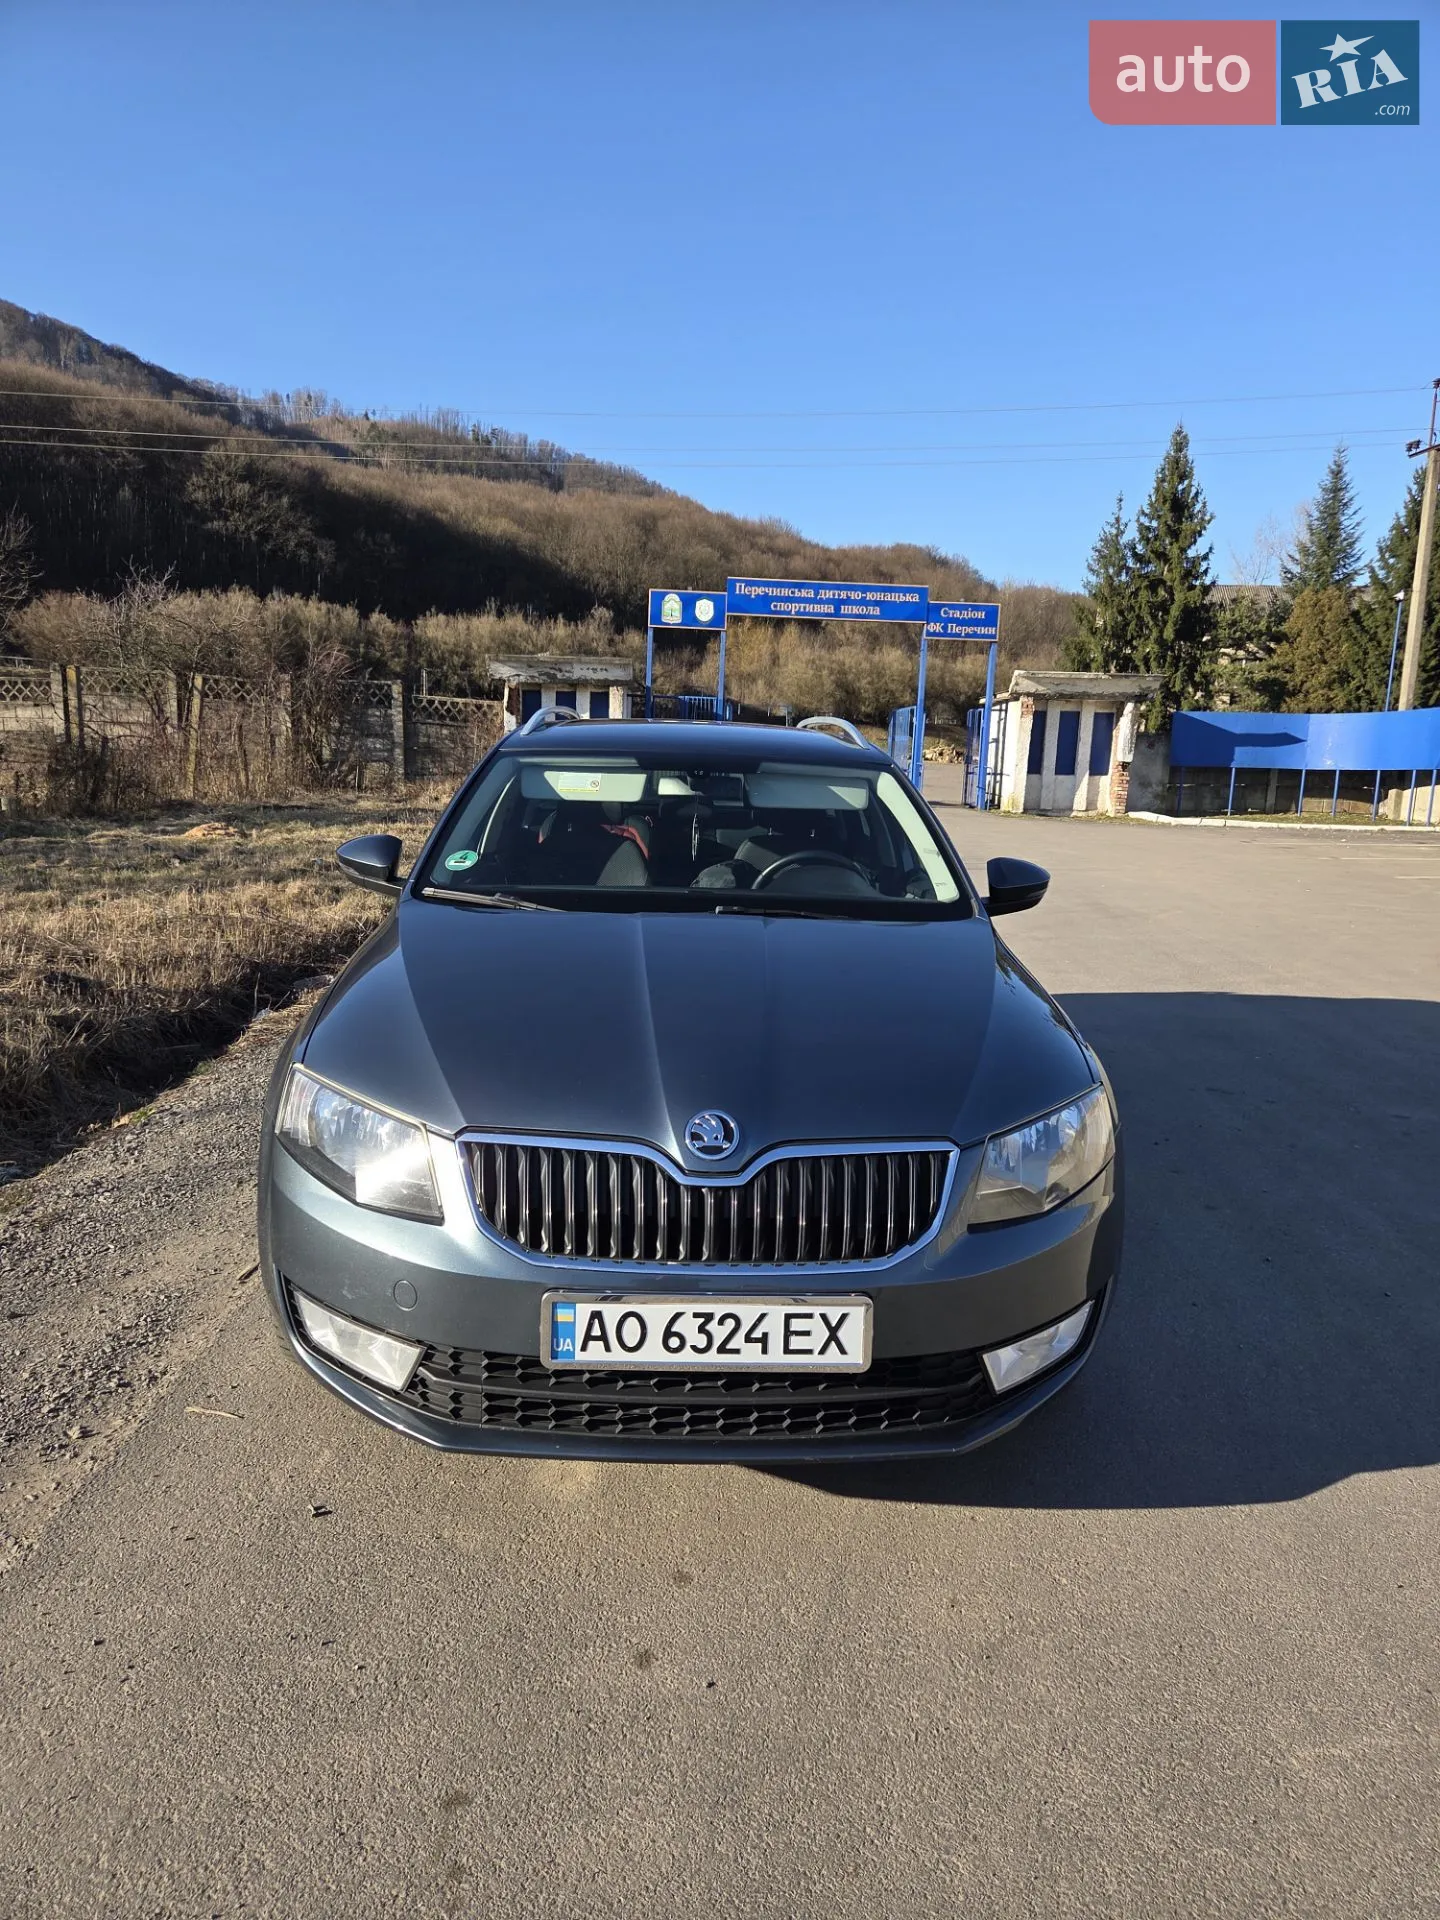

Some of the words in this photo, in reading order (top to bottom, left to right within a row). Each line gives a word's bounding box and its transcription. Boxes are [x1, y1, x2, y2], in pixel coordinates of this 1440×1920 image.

[735, 582, 815, 599] Перечинська
[817, 587, 920, 604] дитячо-юнацька
[770, 601, 835, 614] спортивна
[840, 604, 881, 616] школа
[940, 607, 986, 620] Стадіон
[927, 622, 945, 633] ФК
[947, 623, 996, 637] Перечин
[579, 1310, 647, 1354] AO
[661, 1311, 769, 1355] 6324
[783, 1312, 850, 1356] EX
[553, 1337, 573, 1352] UA
